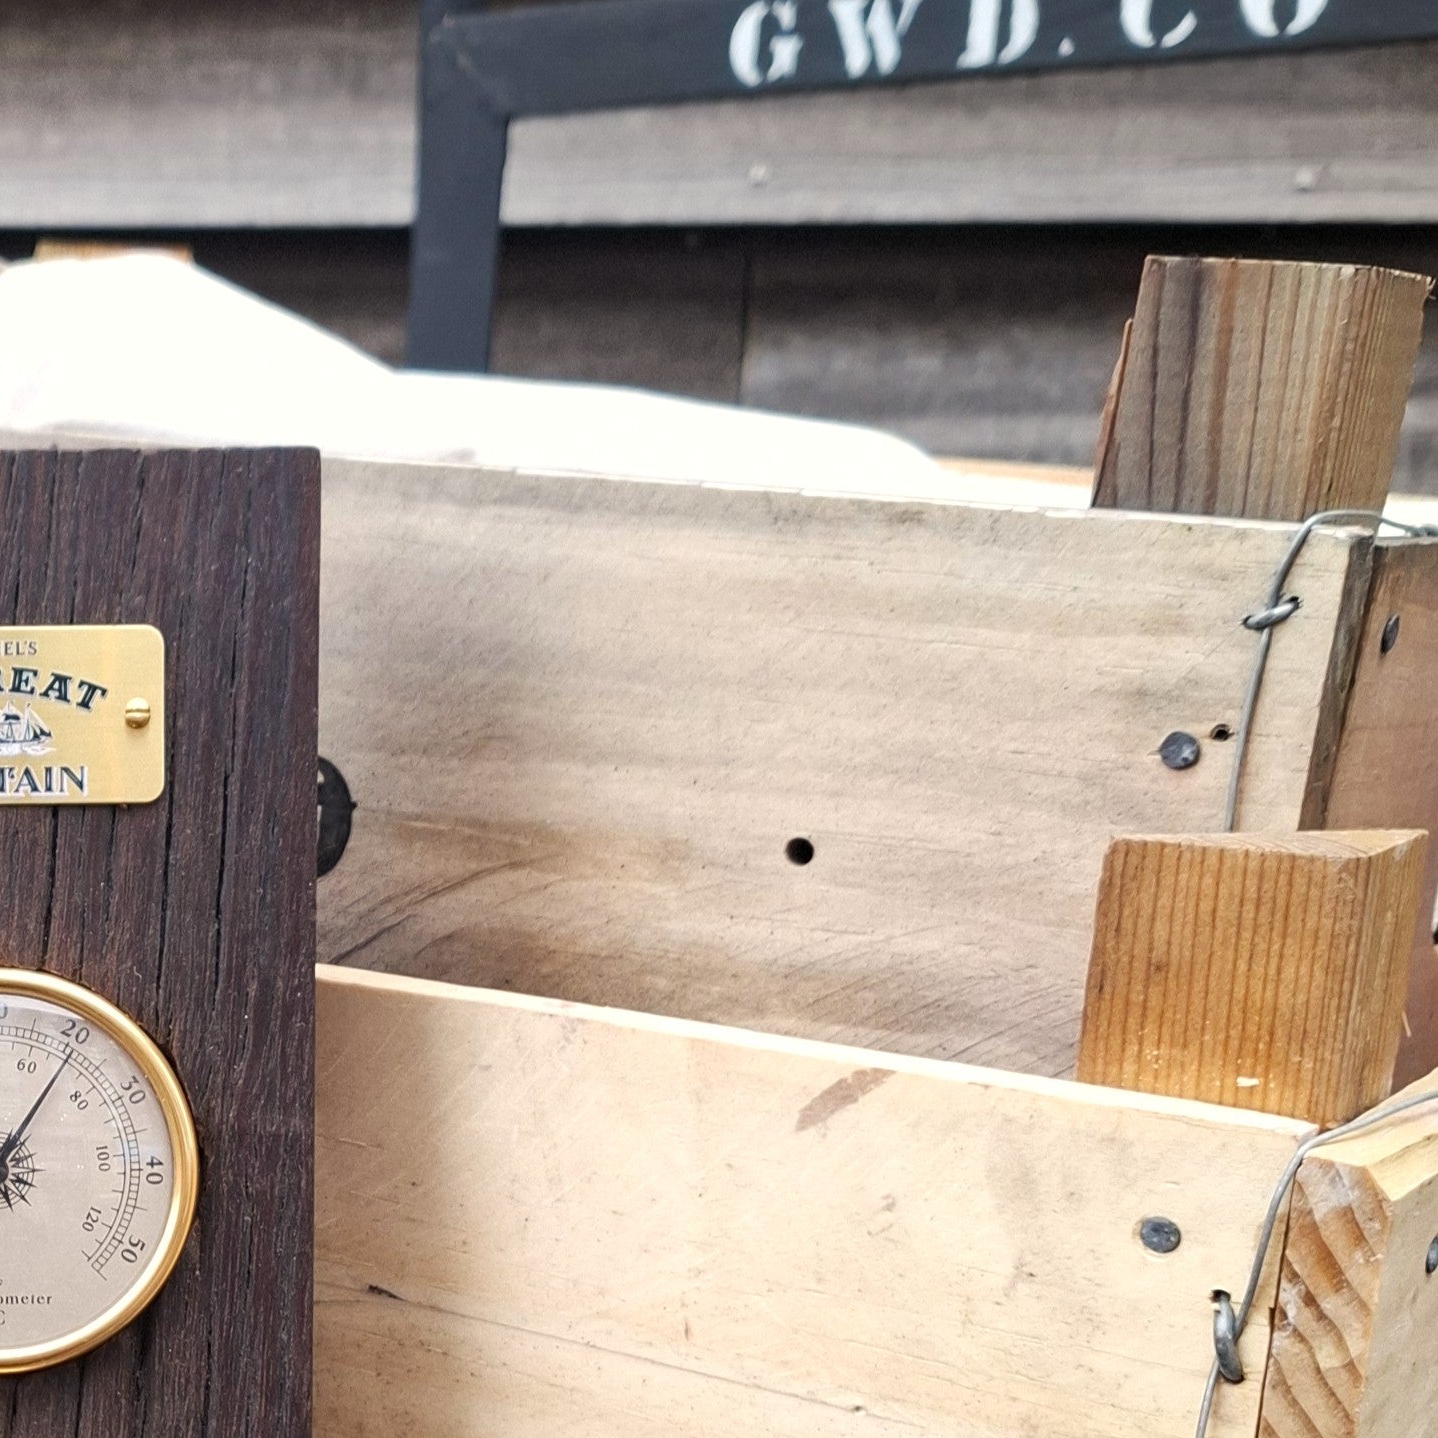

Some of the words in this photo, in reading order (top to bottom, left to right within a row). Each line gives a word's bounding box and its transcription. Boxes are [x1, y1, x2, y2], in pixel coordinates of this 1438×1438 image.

[60, 1019, 89, 1045] 20
[17, 1058, 37, 1074] 60
[69, 1091, 88, 1110] 80
[121, 1075, 146, 1104] 30
[95, 1145, 110, 1172] 100
[146, 1155, 163, 1185] 40
[82, 1207, 101, 1232] 120
[121, 1238, 145, 1264] 50
